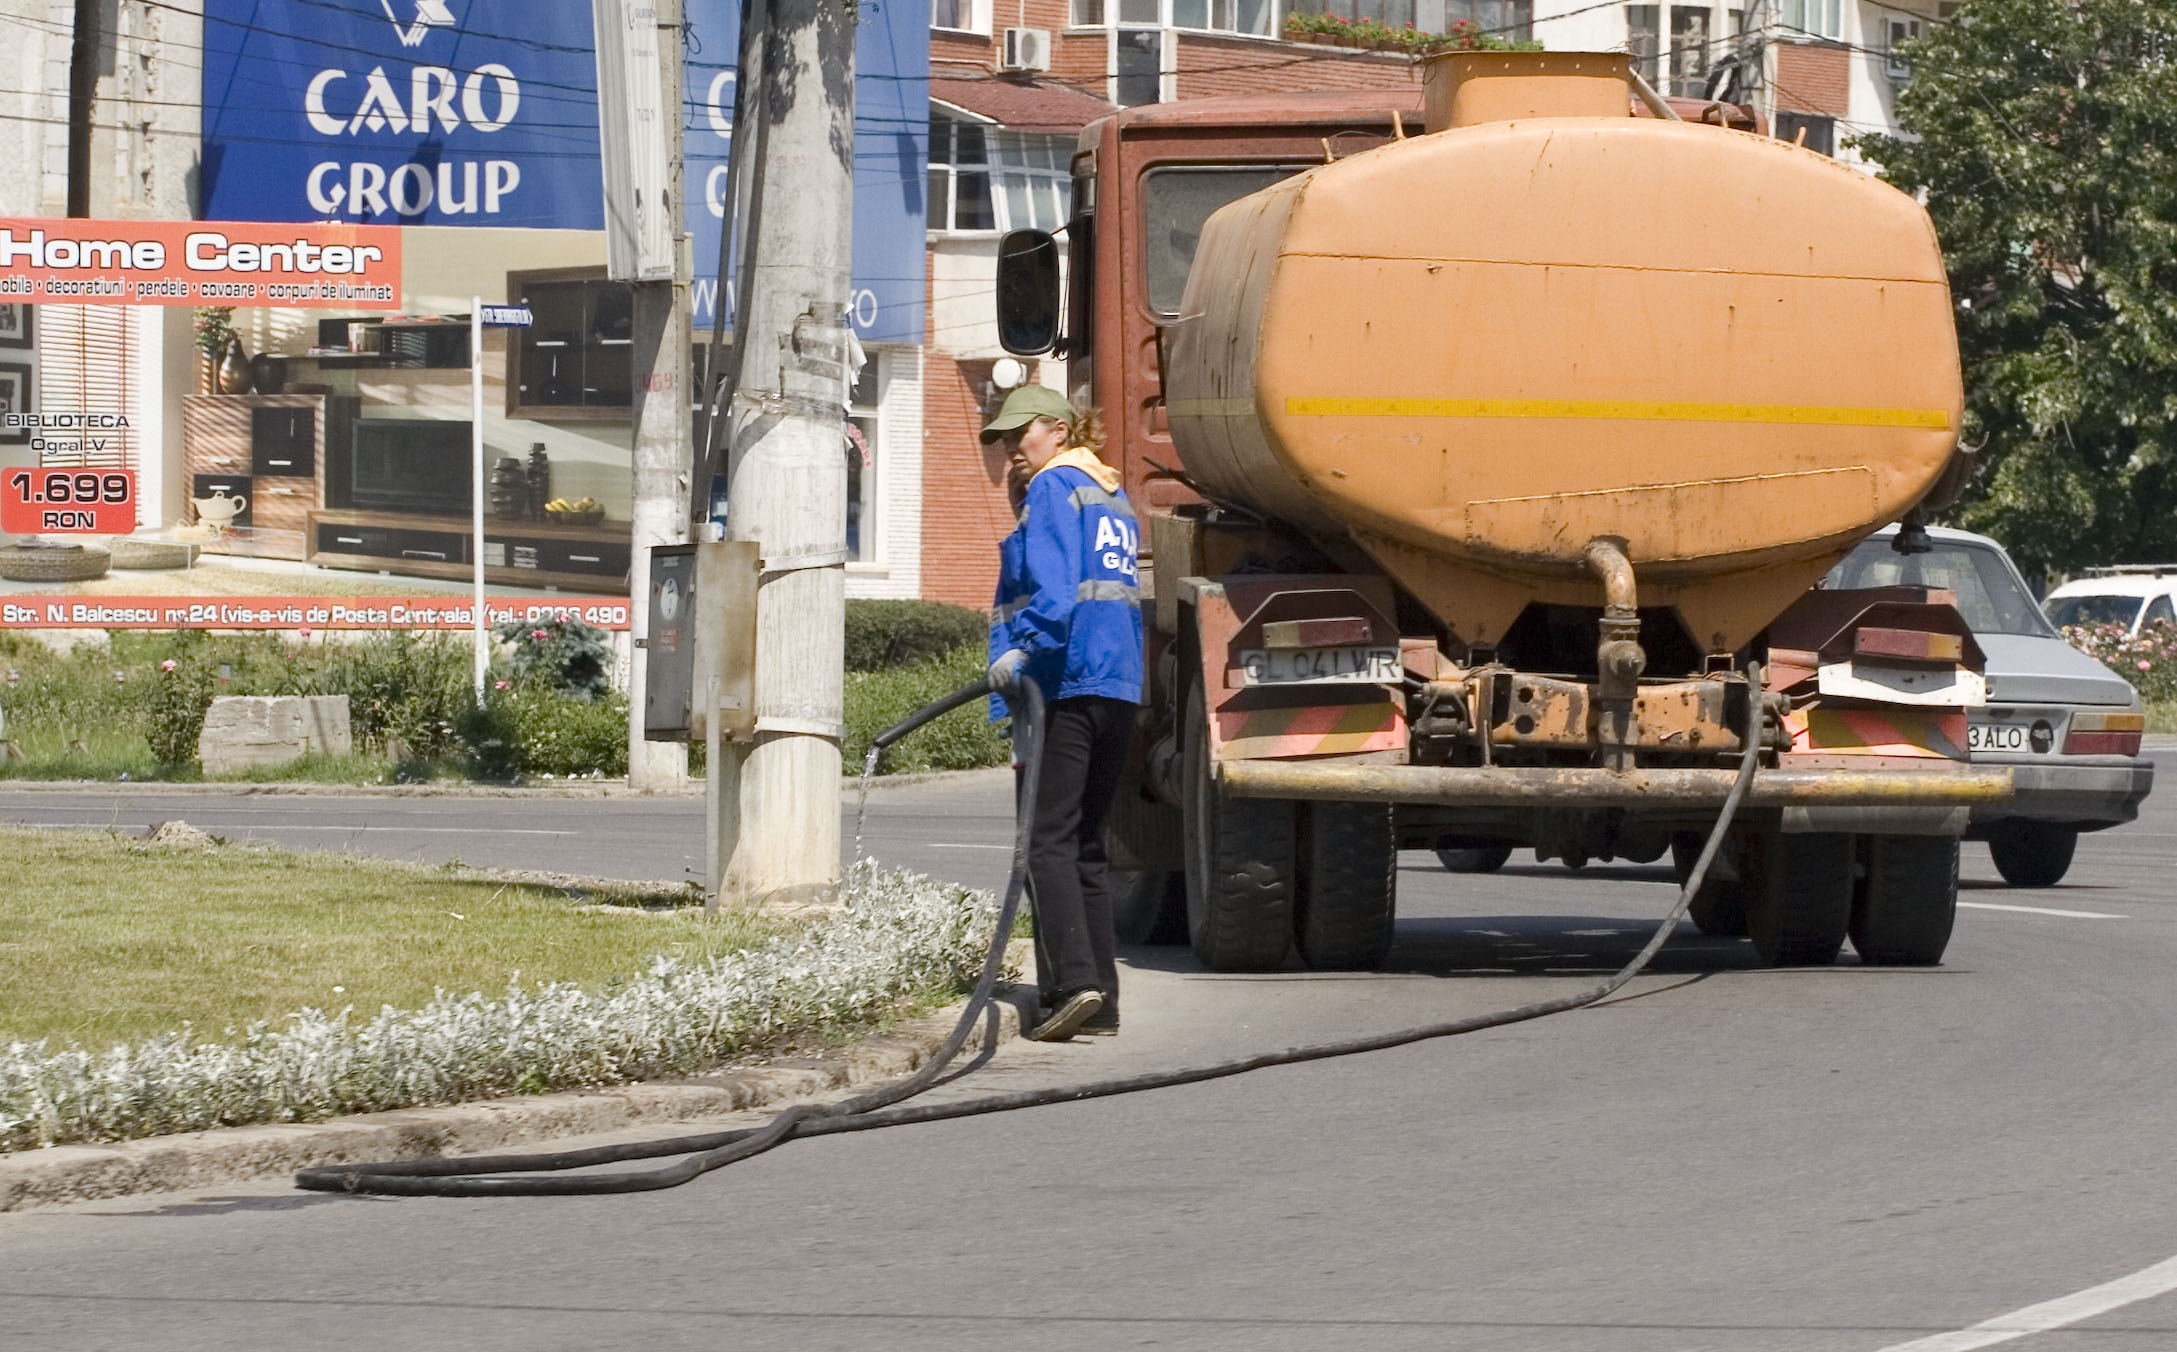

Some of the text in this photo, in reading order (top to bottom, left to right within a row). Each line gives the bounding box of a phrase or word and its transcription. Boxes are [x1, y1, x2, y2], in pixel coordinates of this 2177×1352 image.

[304, 63, 520, 137] CARO
[306, 160, 521, 217] GROUP
[0, 229, 383, 274] Home Center
[0, 275, 34, 294] obila
[45, 275, 125, 297] decoratiuni
[136, 277, 189, 301] perdele
[200, 282, 256, 299] covoare
[268, 280, 320, 304] corpuri
[6, 414, 130, 428] BIBLIOTECA
[11, 472, 130, 504] 1.699
[42, 511, 95, 529] RON
[3, 604, 40, 623] Str.
[47, 604, 69, 623] N.
[72, 604, 158, 623] Balcescu
[221, 605, 303, 624] (vis-a-vis
[306, 605, 329, 623] de
[332, 605, 388, 624] Posta
[585, 606, 627, 624] 490
[1246, 653, 1280, 679] GL
[1984, 726, 2022, 748] ALO
